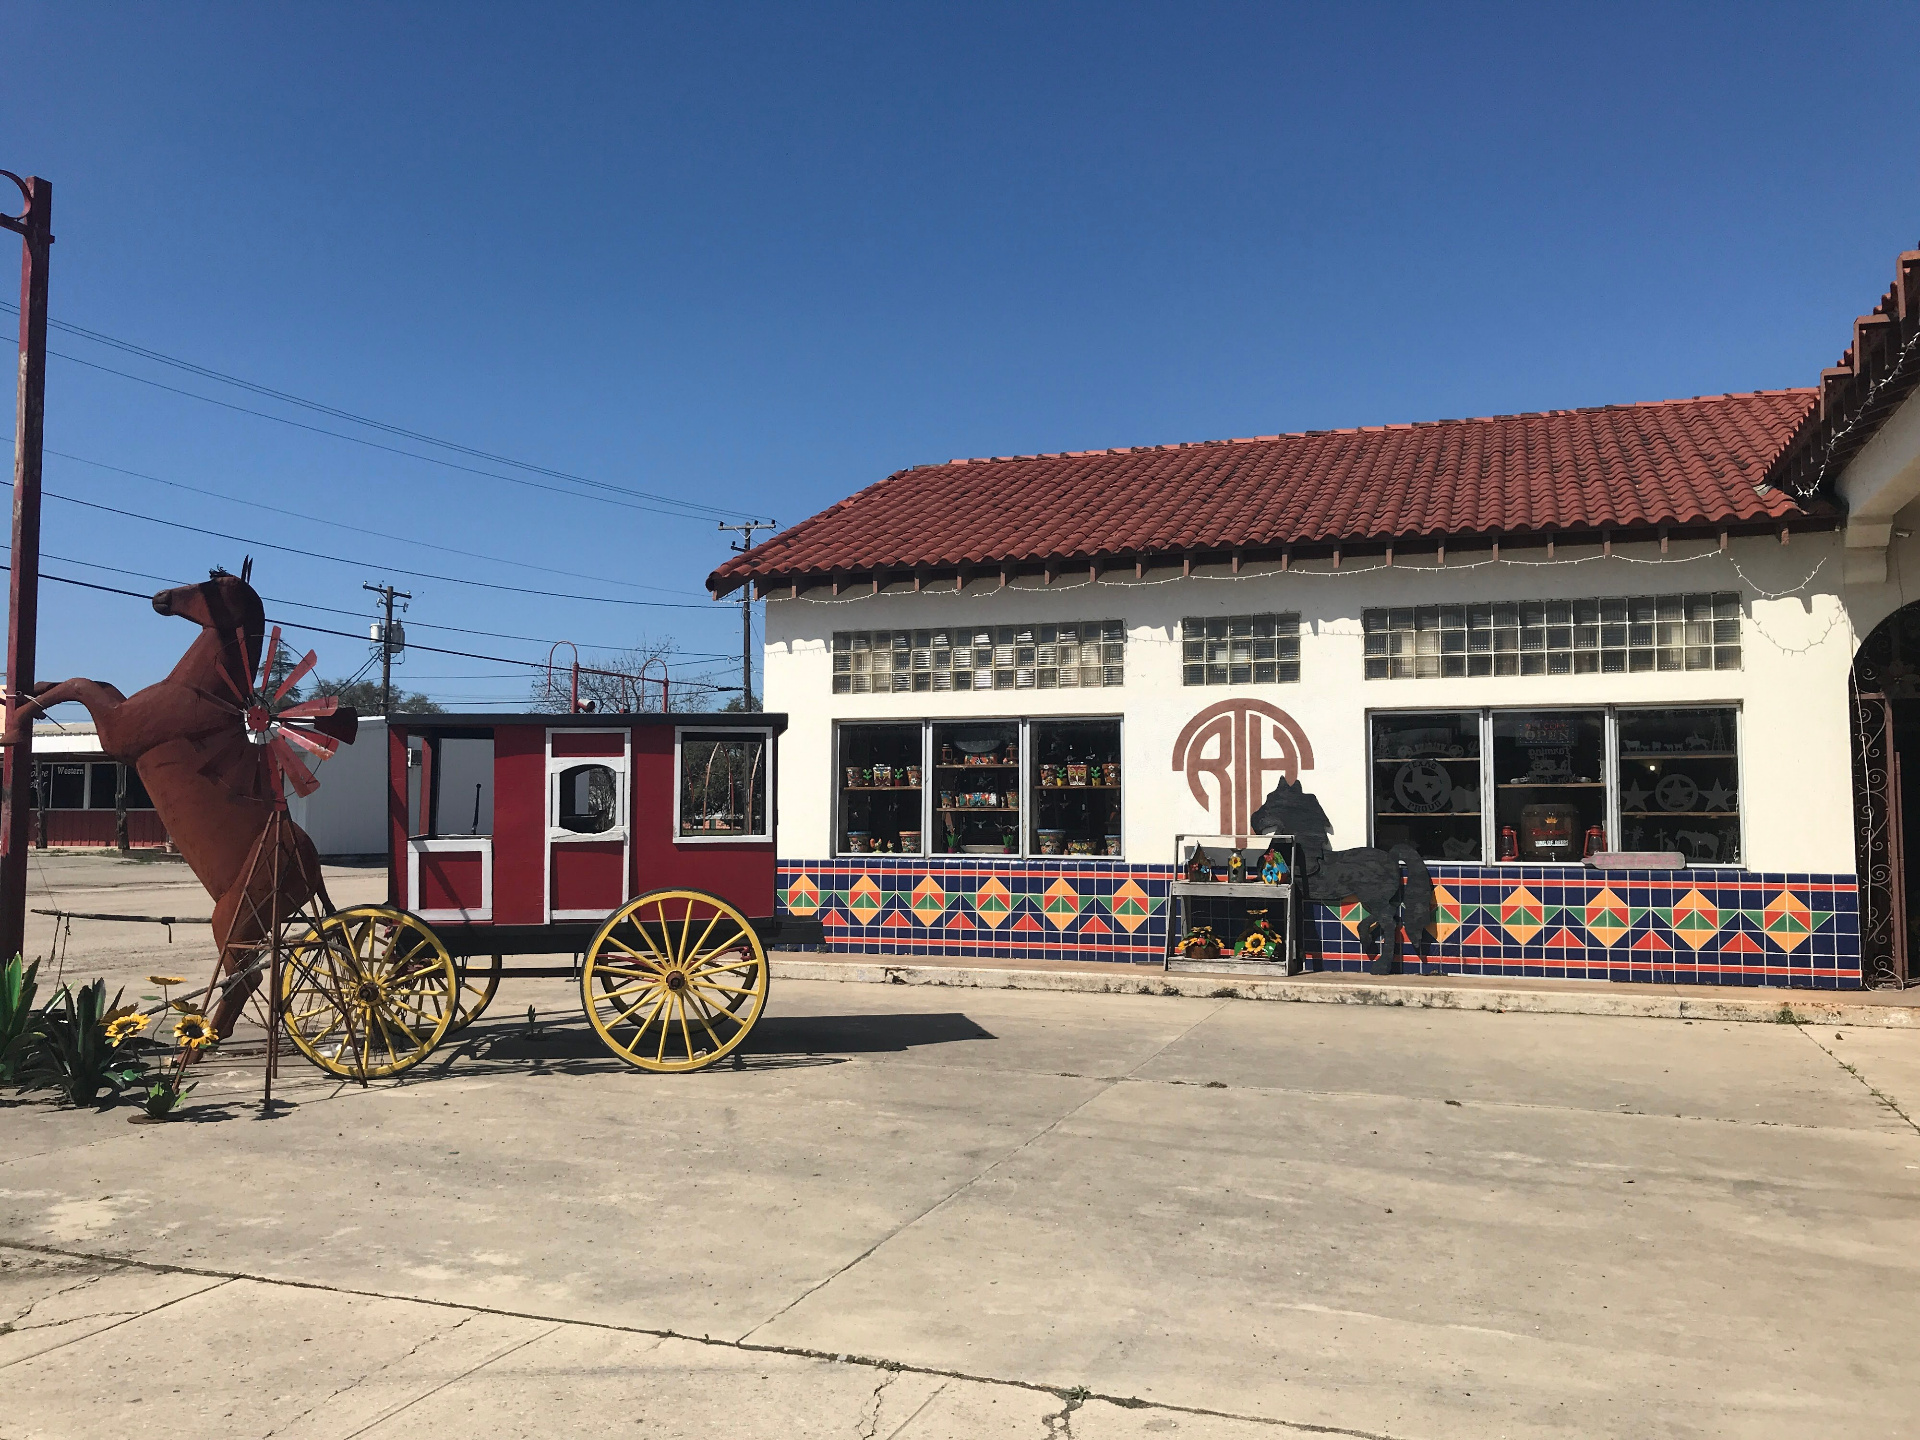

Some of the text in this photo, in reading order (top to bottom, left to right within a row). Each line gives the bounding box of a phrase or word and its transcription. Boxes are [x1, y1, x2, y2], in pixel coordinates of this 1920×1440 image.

[1524, 729, 1569, 741] OPEN
[57, 766, 84, 775] Western
[1405, 760, 1437, 770] TEXAS
[1407, 799, 1442, 812] PROUD
